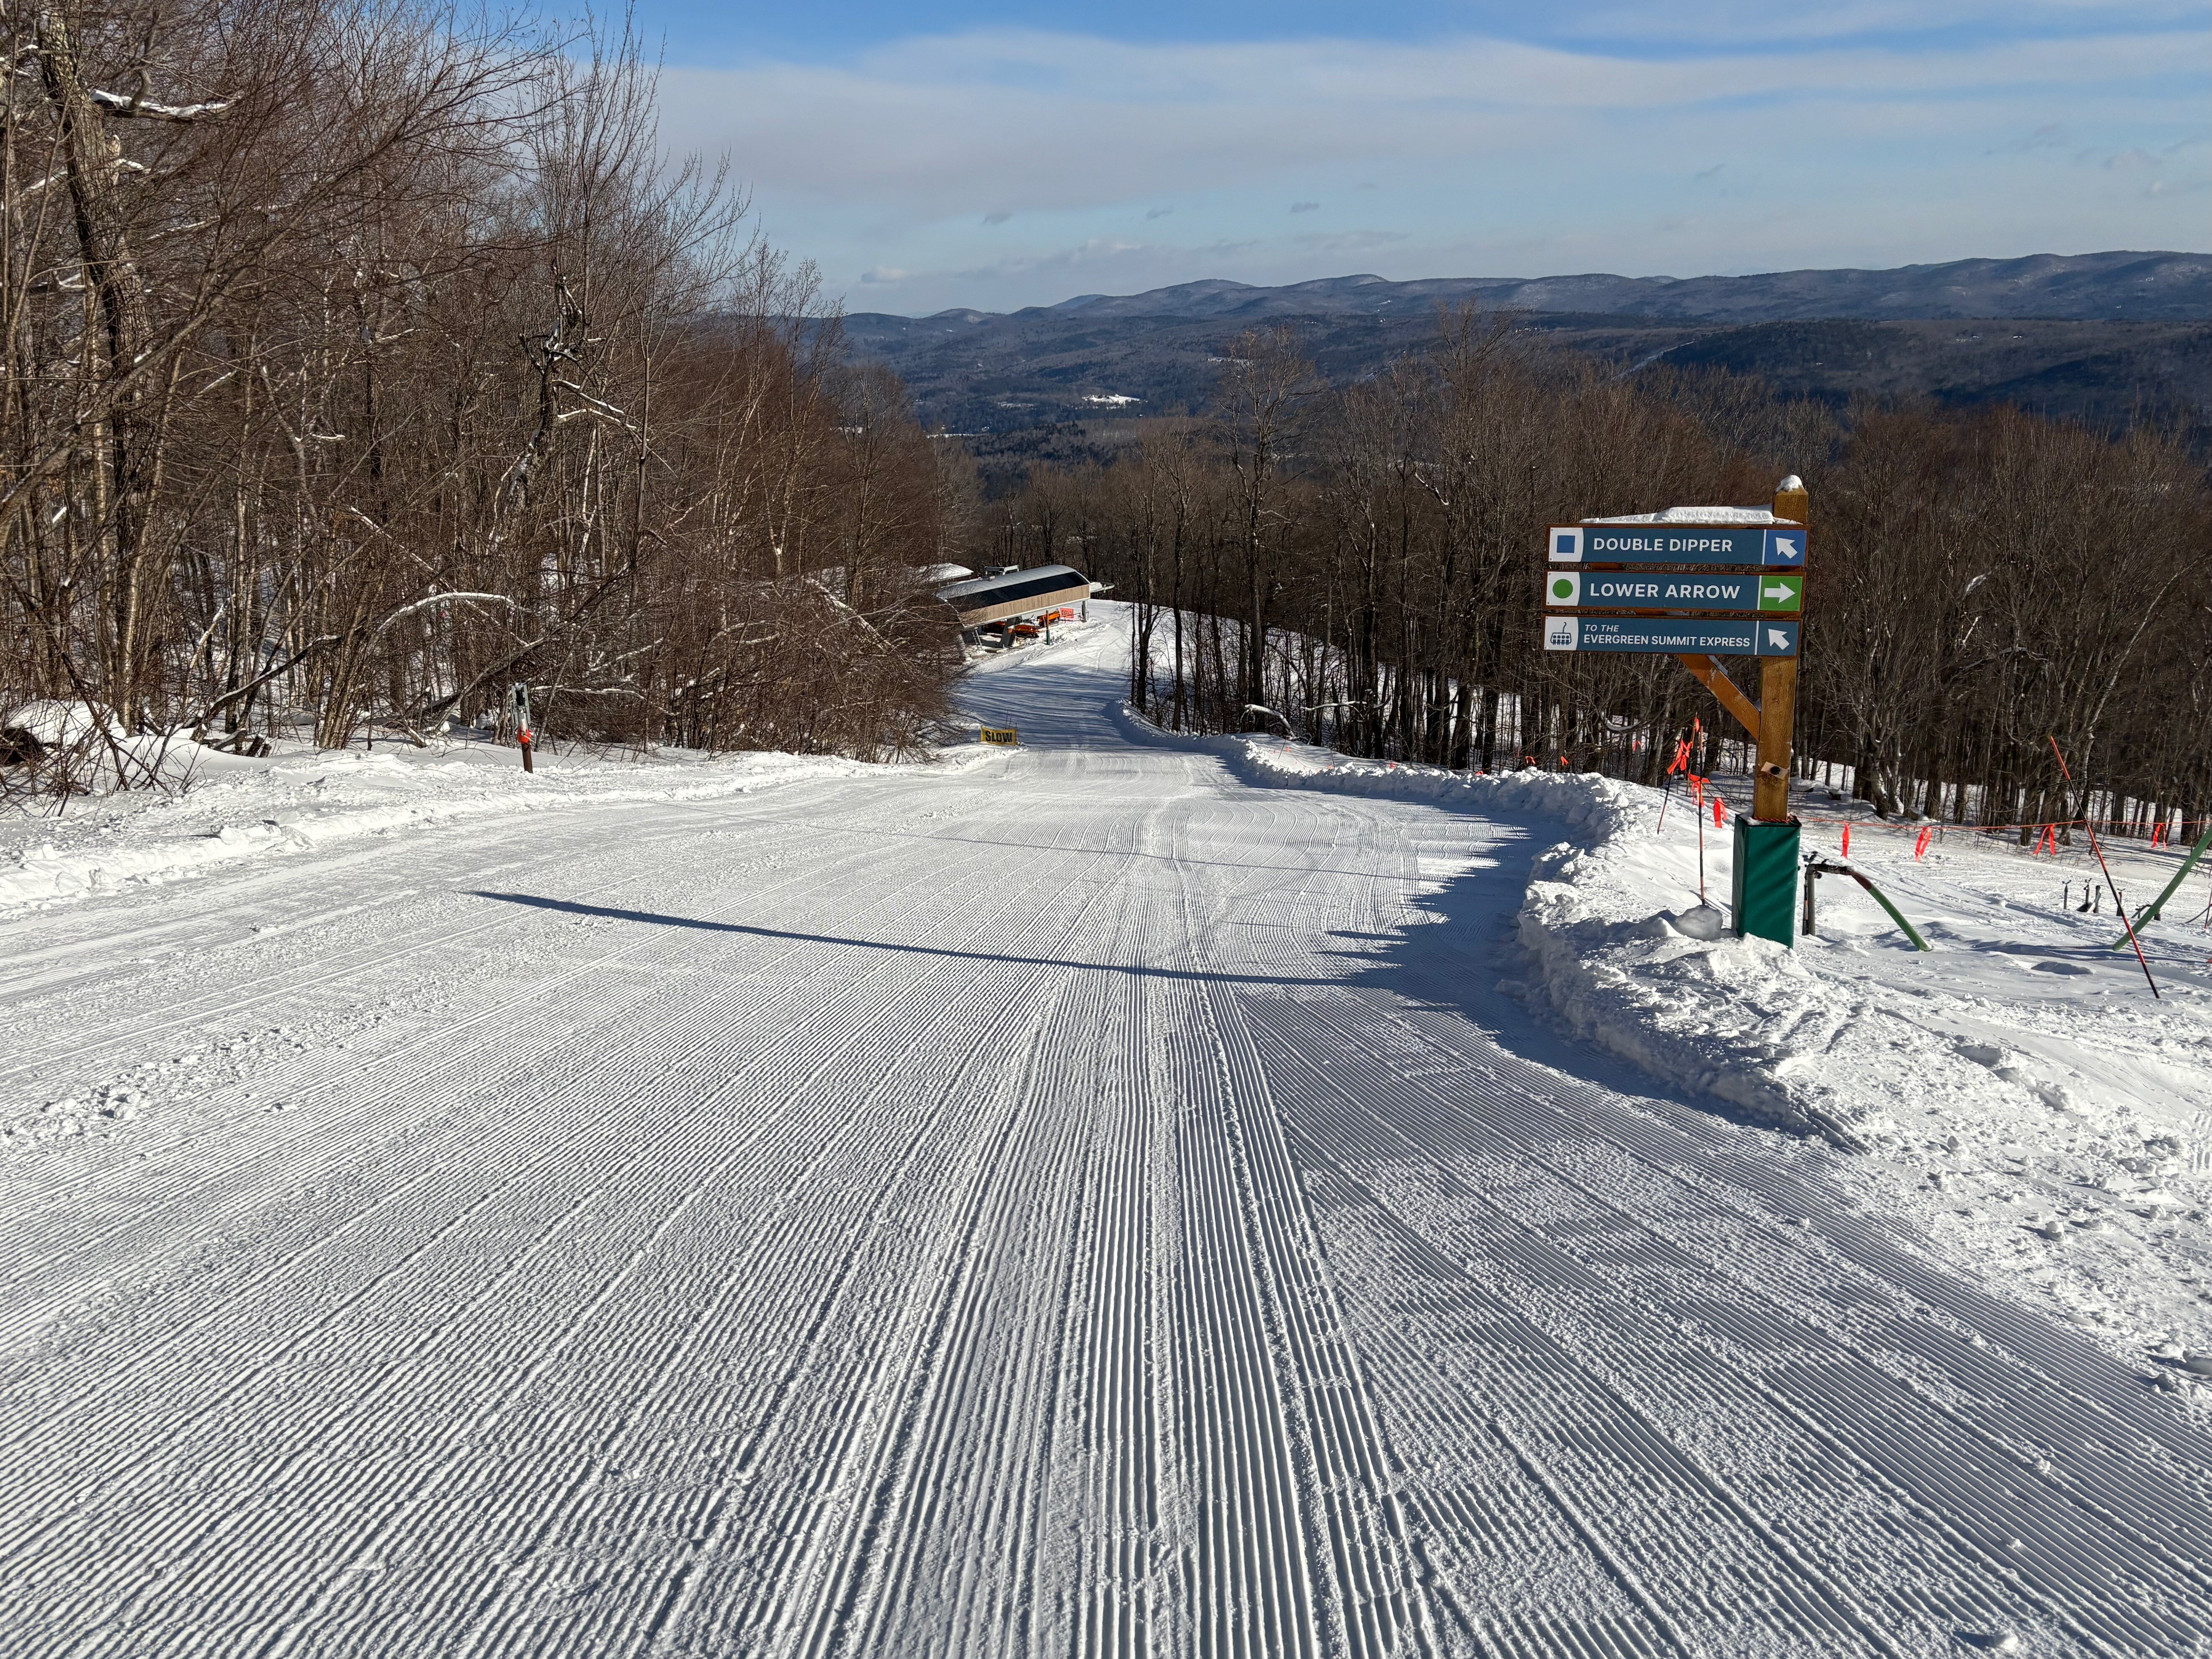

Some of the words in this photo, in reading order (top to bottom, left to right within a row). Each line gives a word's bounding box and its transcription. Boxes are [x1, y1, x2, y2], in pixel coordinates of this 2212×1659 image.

[1594, 537, 1663, 551] DOUBLE
[1669, 539, 1732, 552] DIPPER
[1590, 583, 1658, 598] LOWER
[1665, 585, 1740, 599] ARROW
[1584, 634, 1648, 644] EVERGREEN
[1651, 636, 1697, 646] SUMMIT
[1700, 637, 1750, 647] EXPRESS
[985, 730, 1012, 742] SLOW
